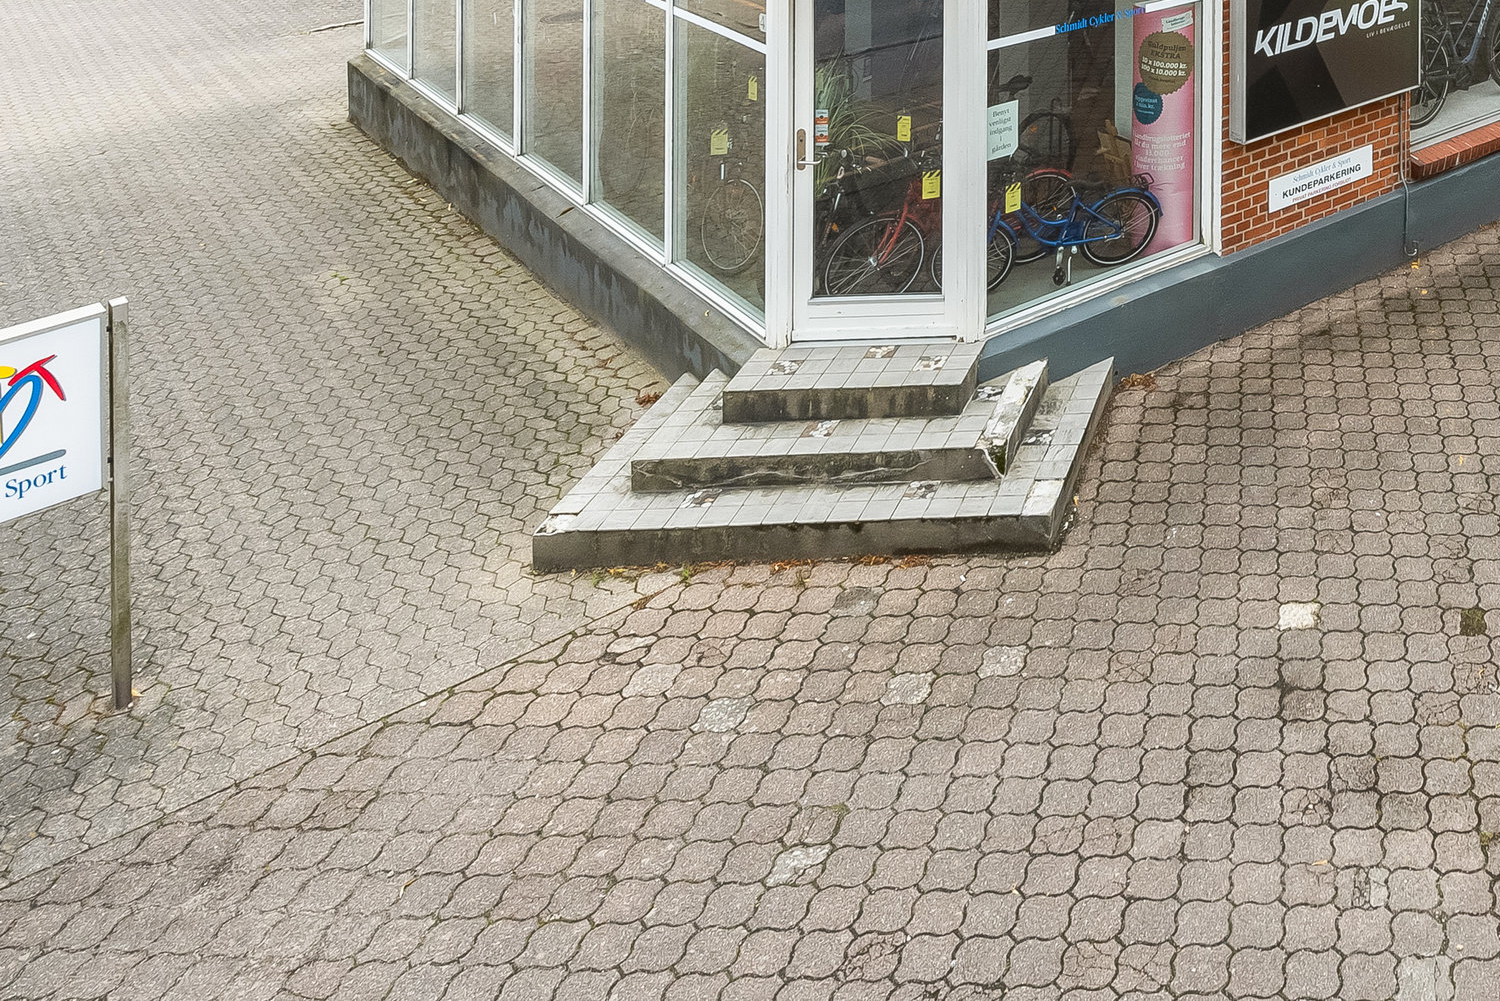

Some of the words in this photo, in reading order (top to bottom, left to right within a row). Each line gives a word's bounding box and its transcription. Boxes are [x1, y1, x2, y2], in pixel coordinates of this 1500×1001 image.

[1055, 17, 1088, 35] Schmidt
[1088, 12, 1115, 28] Cykler
[1116, 10, 1123, 20] &
[1124, 6, 1145, 18] Sport
[1366, 30, 1375, 39] LIV
[1379, 20, 1411, 35] BEVÆGELSE
[1150, 49, 1181, 59] EKSTRA
[1141, 63, 1150, 71] 100
[1153, 60, 1179, 69] 100.000
[992, 108, 1010, 118] Benyt
[989, 125, 1013, 136] indgang
[991, 142, 1012, 154] gården
[1141, 141, 1150, 149] du
[1172, 139, 1187, 148] end
[1292, 170, 1314, 183] Schmidt
[1314, 163, 1331, 177] Cykler
[1337, 156, 1352, 168] Sport
[1282, 163, 1362, 199] KUNDEPARKERING
[1292, 192, 1307, 203] PRIVAT
[1307, 184, 1332, 197] PARKERING
[5, 464, 68, 500] Sport
